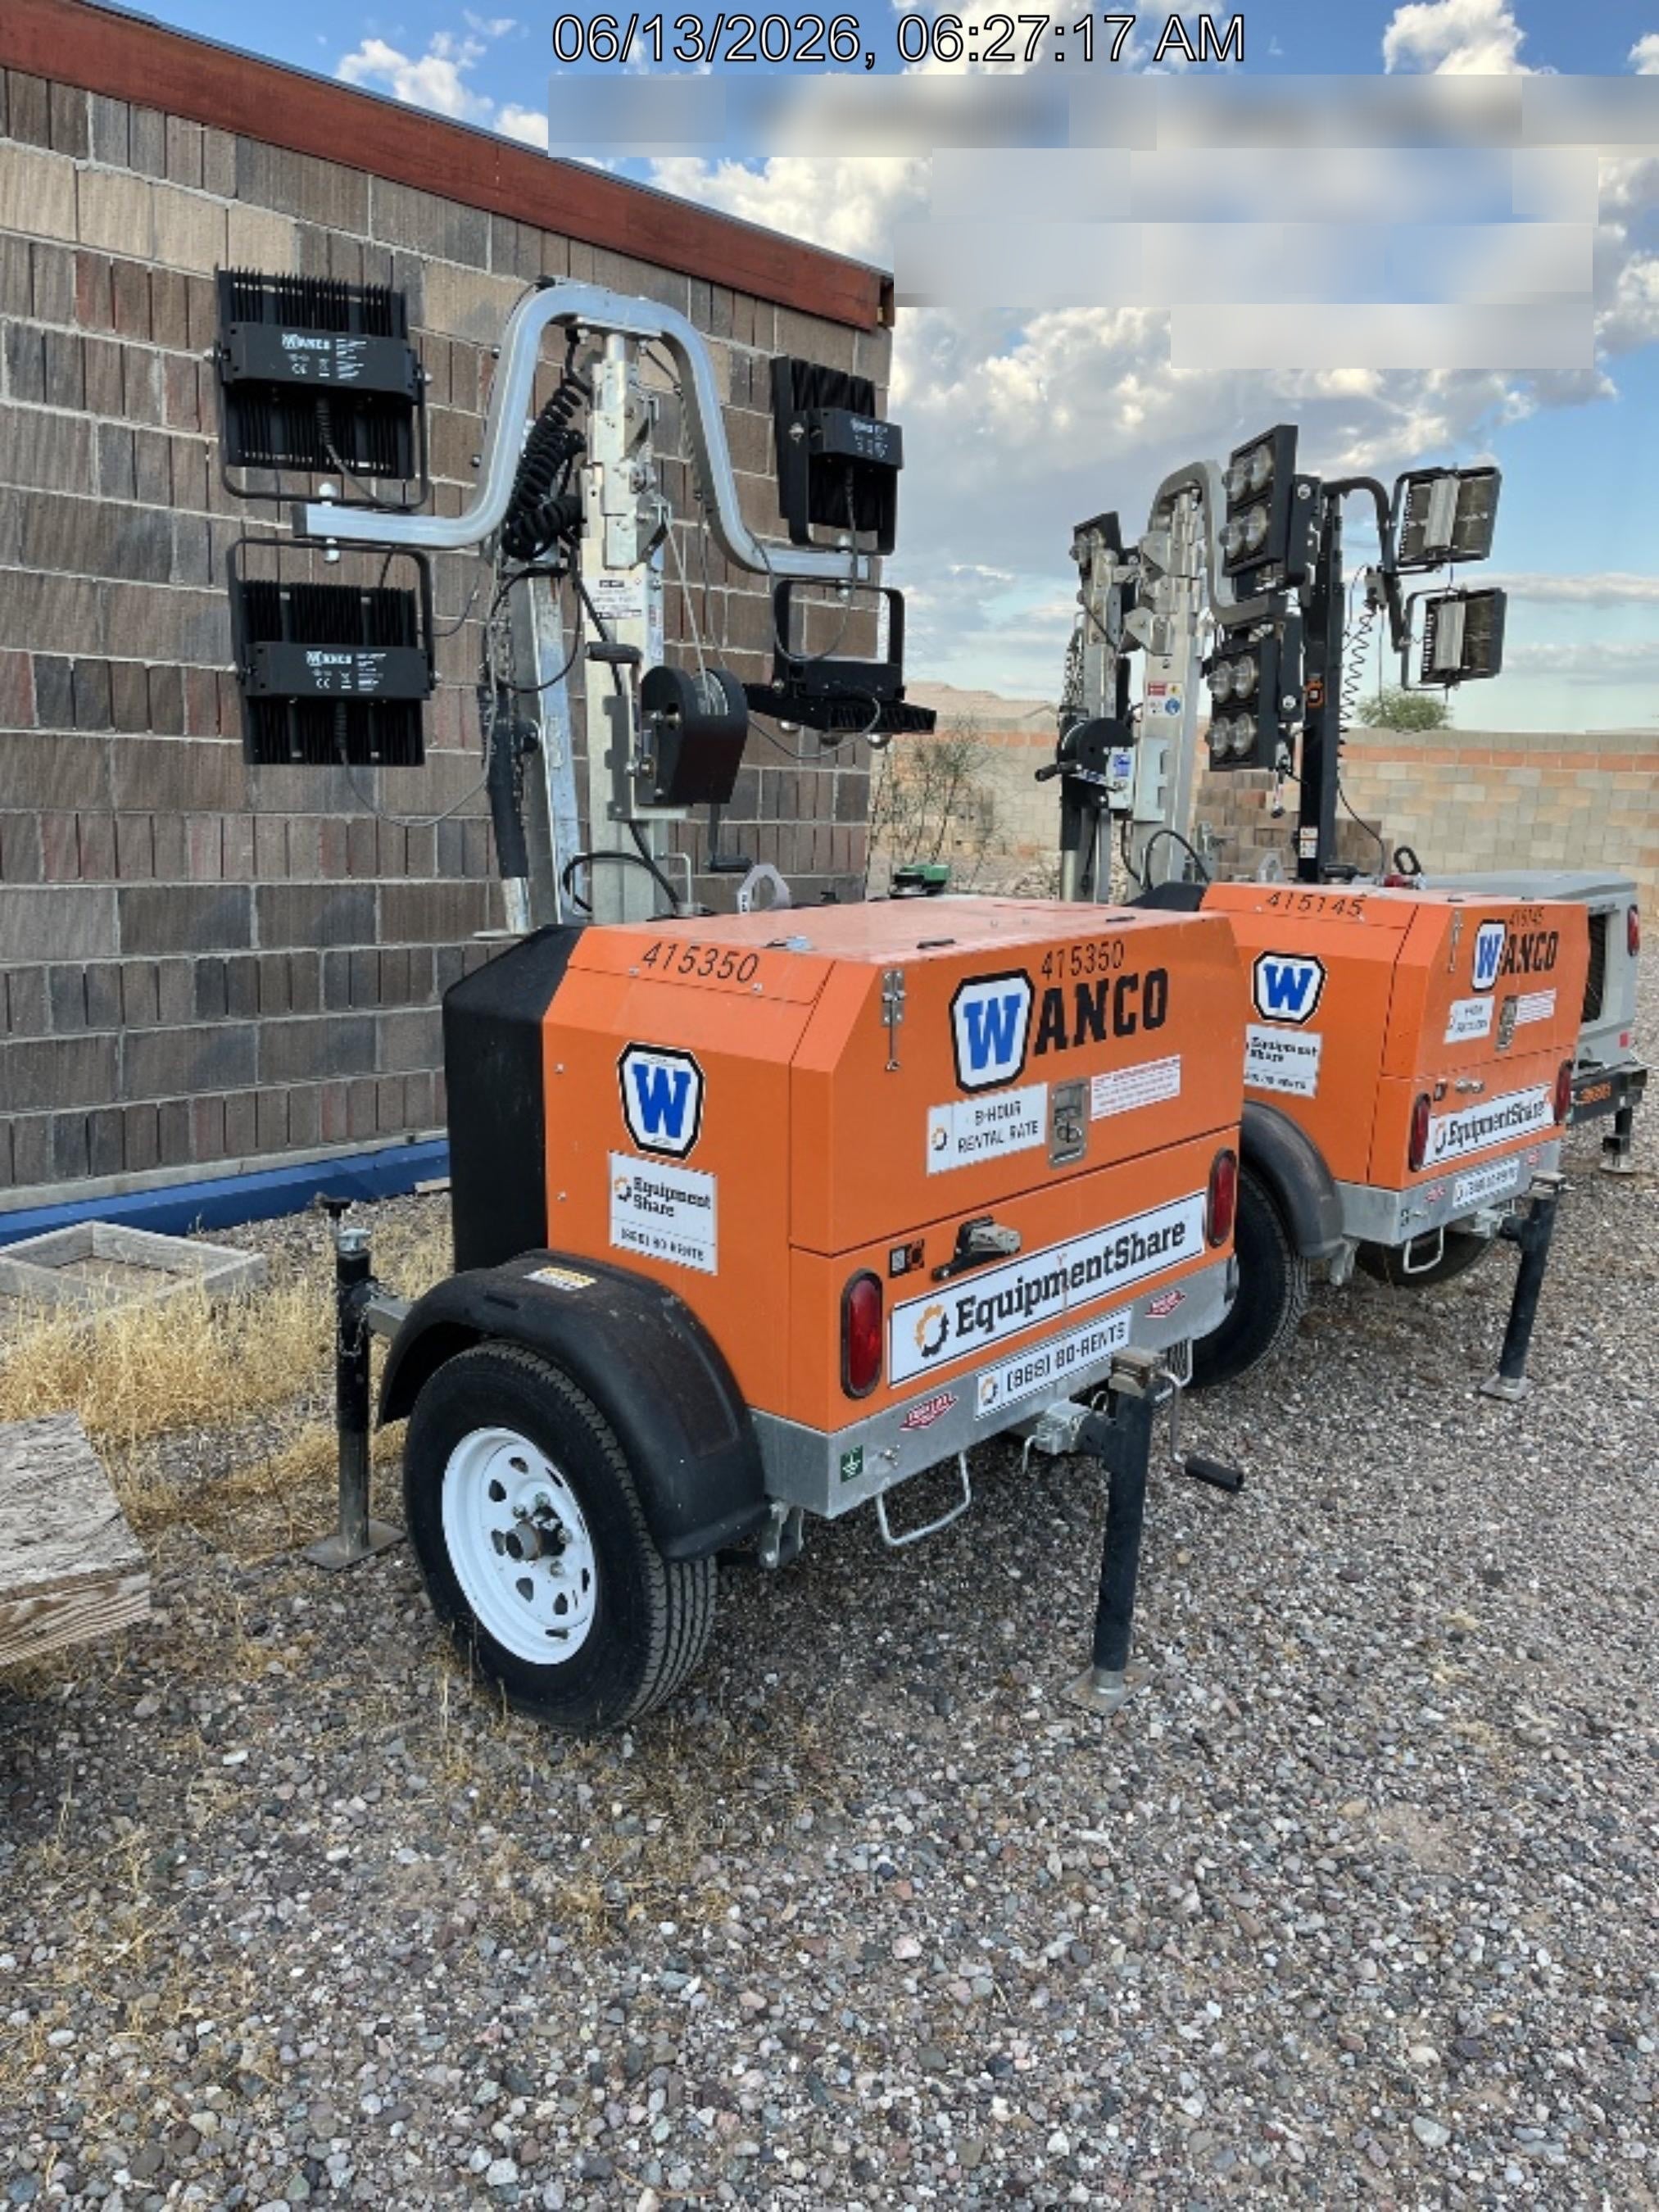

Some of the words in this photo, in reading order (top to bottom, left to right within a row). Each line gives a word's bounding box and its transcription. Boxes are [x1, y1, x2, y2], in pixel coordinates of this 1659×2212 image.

[641, 941, 760, 983] 415350
[1040, 940, 1125, 981] 415350
[1262, 963, 1314, 1013] W
[962, 968, 1169, 1072] WANCO
[631, 1062, 691, 1139] W
[958, 1130, 1005, 1154] RENTAL
[1009, 1119, 1039, 1140] RATE
[632, 1176, 711, 1210] Equipment
[632, 1194, 675, 1217] Share
[954, 1220, 1187, 1339] EquipmentShare
